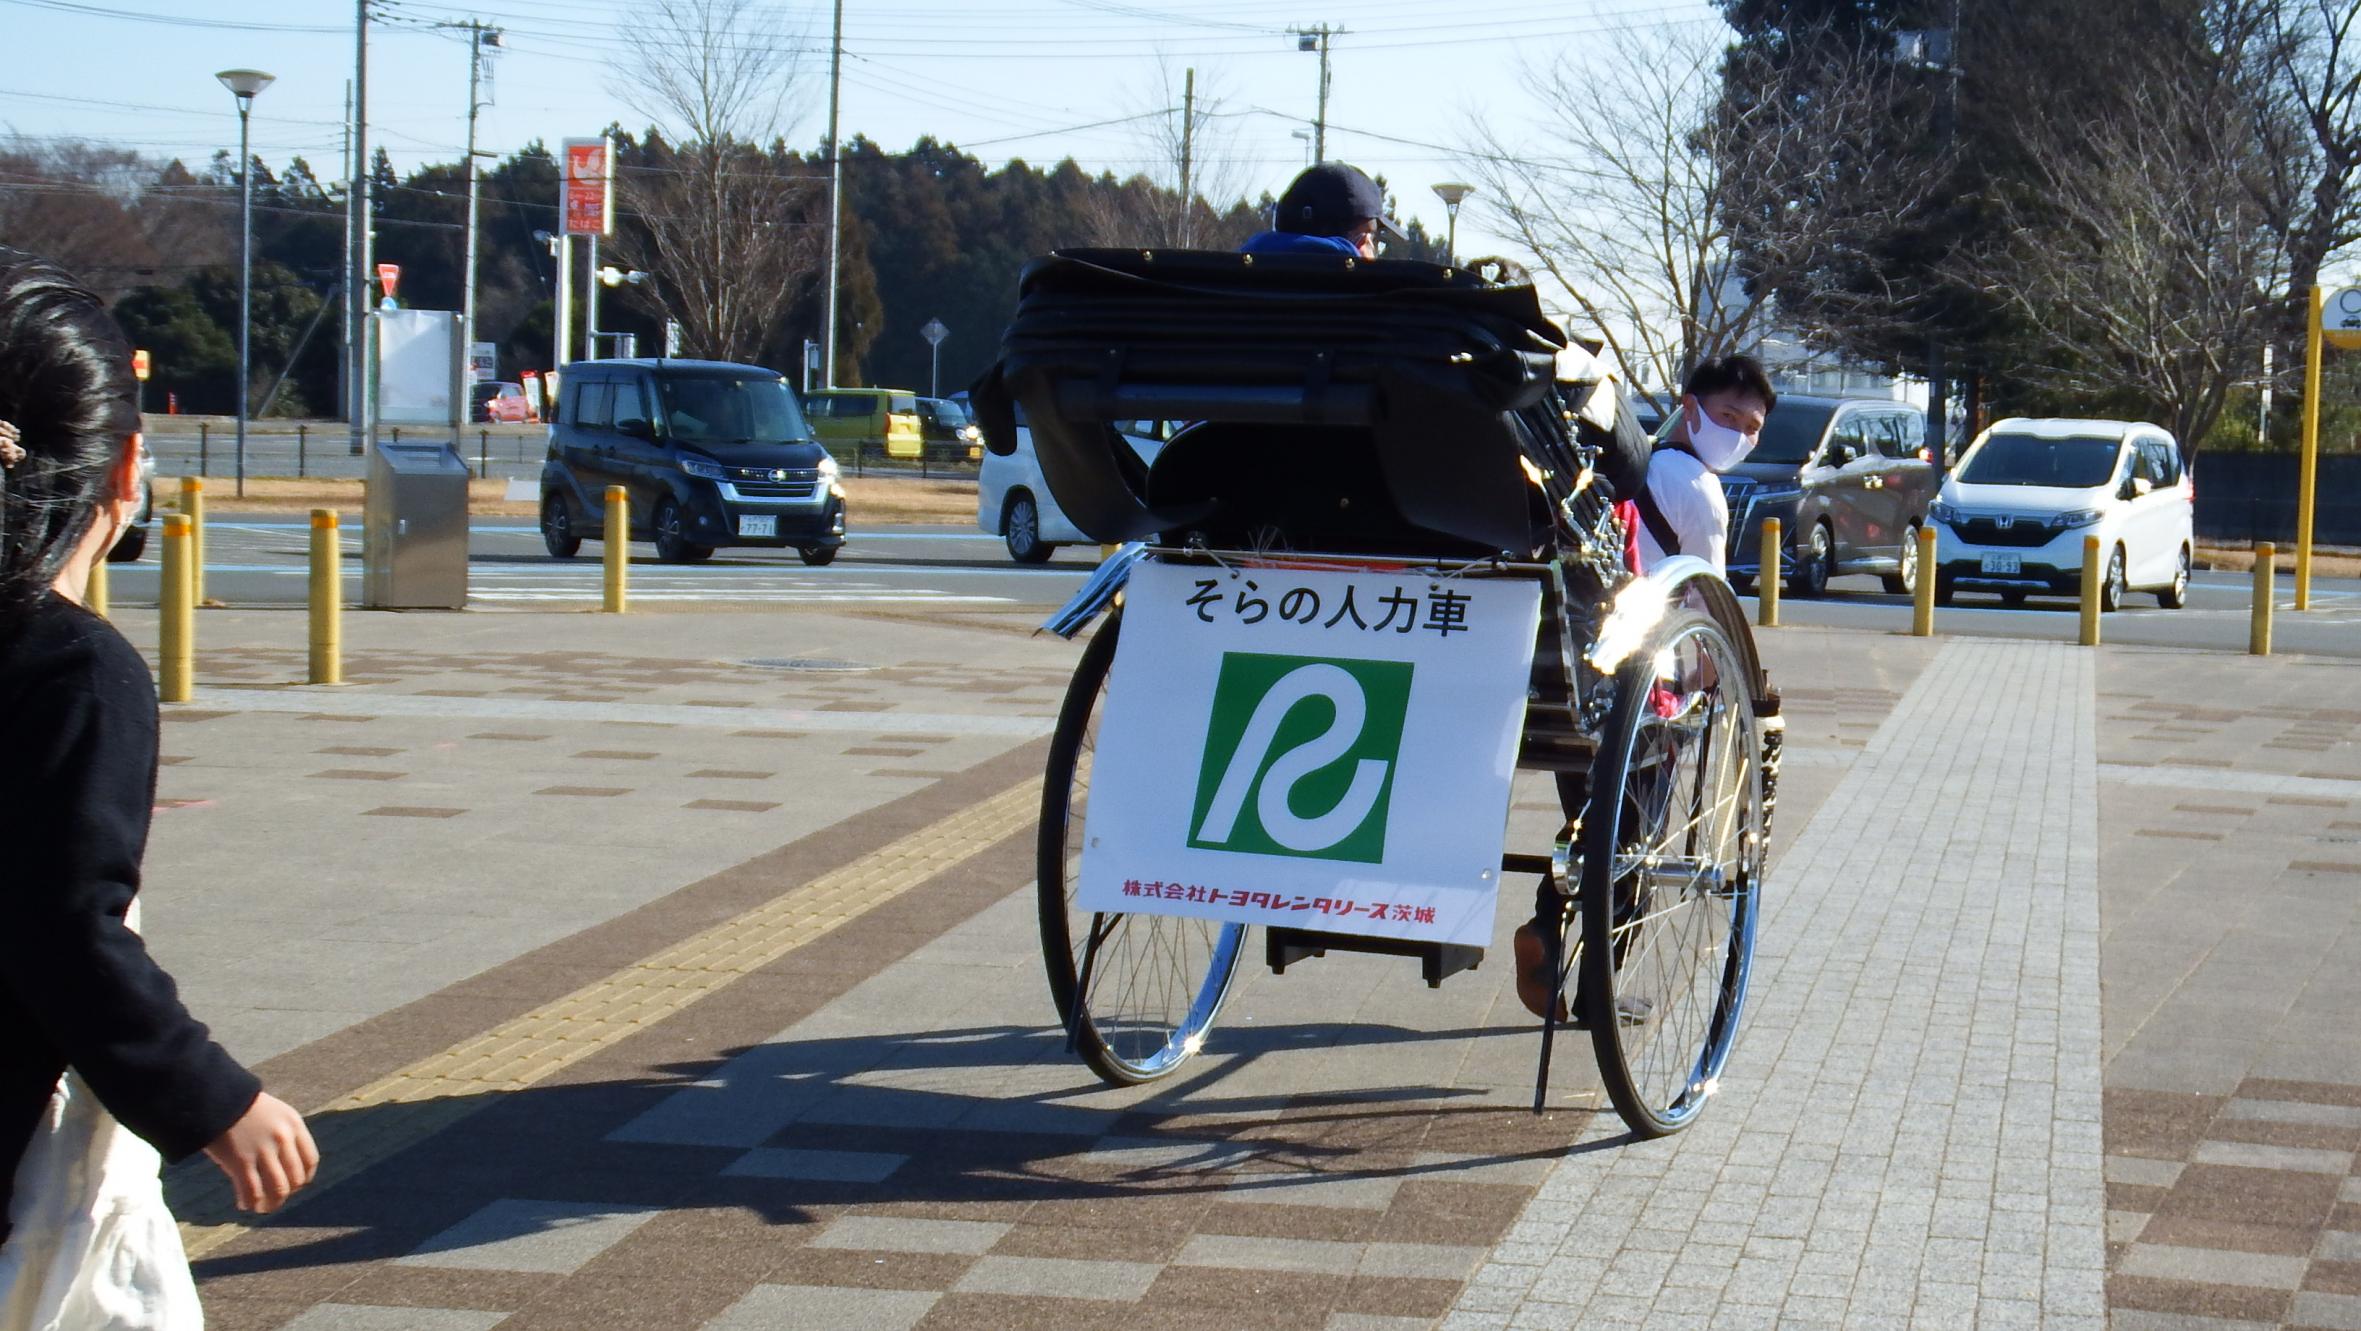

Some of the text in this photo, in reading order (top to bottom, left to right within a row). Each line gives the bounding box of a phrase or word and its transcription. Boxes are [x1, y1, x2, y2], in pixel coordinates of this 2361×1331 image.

[1186, 579, 1472, 637] そらの人力車
[1122, 879, 1436, 924] 株式会社トヨタレンタリース茨城
